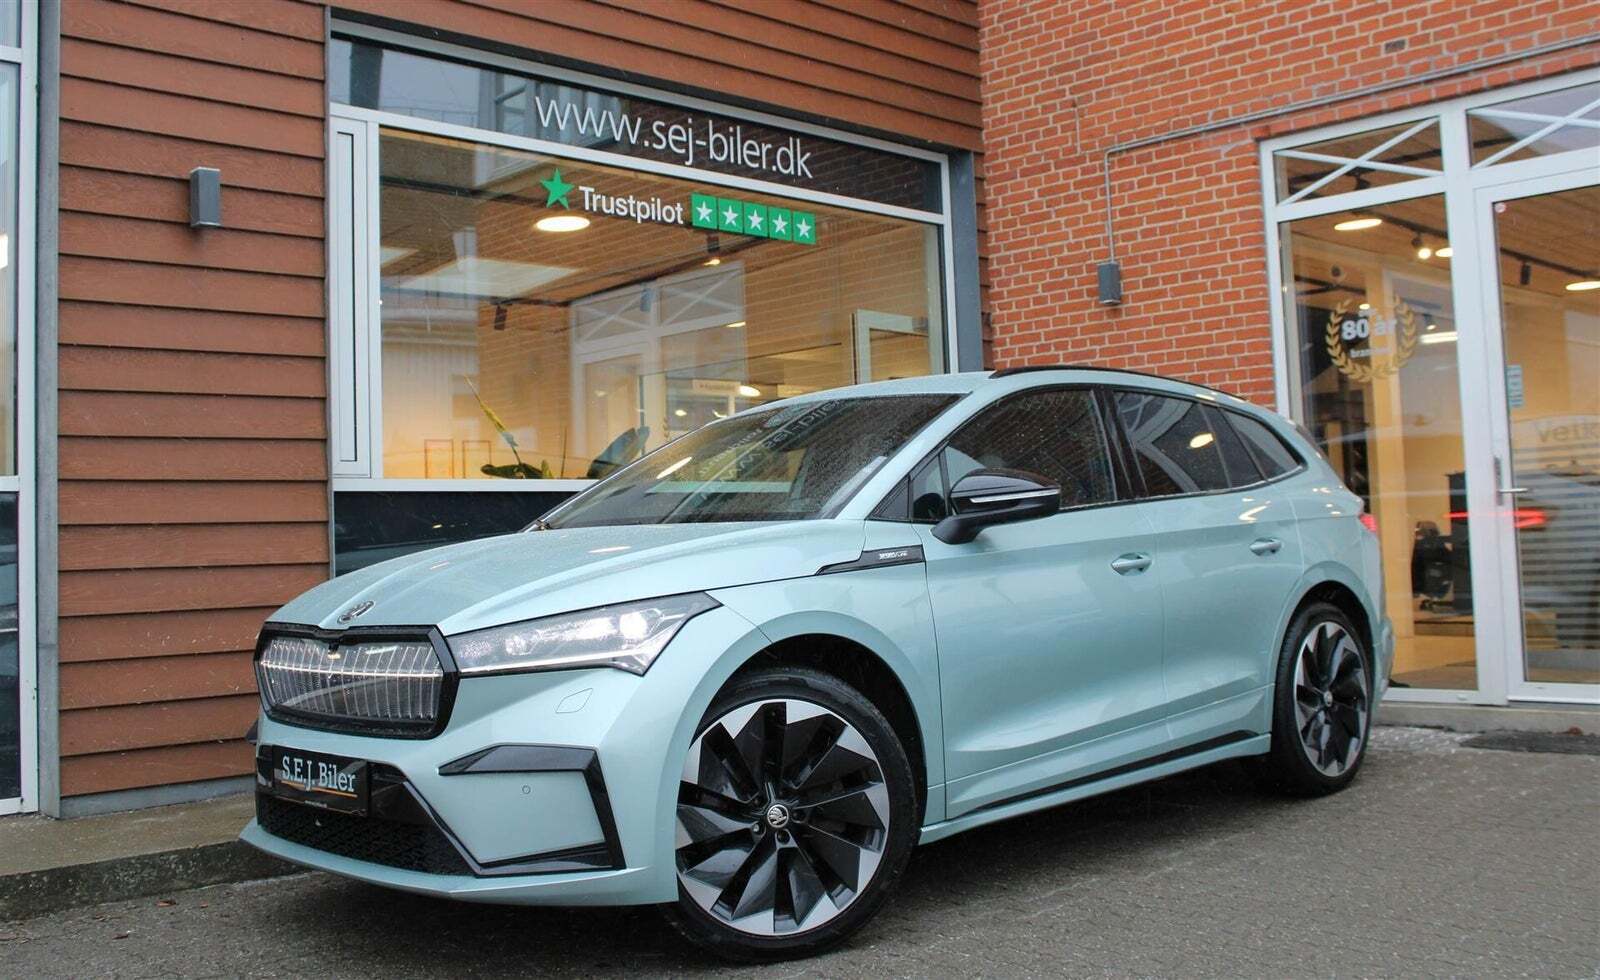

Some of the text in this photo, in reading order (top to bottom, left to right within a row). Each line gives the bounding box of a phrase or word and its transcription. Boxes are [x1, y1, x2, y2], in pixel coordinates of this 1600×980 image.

[535, 96, 813, 179] www.sej-biler.dk
[579, 185, 684, 225] Trustpilot
[1341, 318, 1369, 341] 80
[282, 755, 356, 793] S.E.J. Biler
